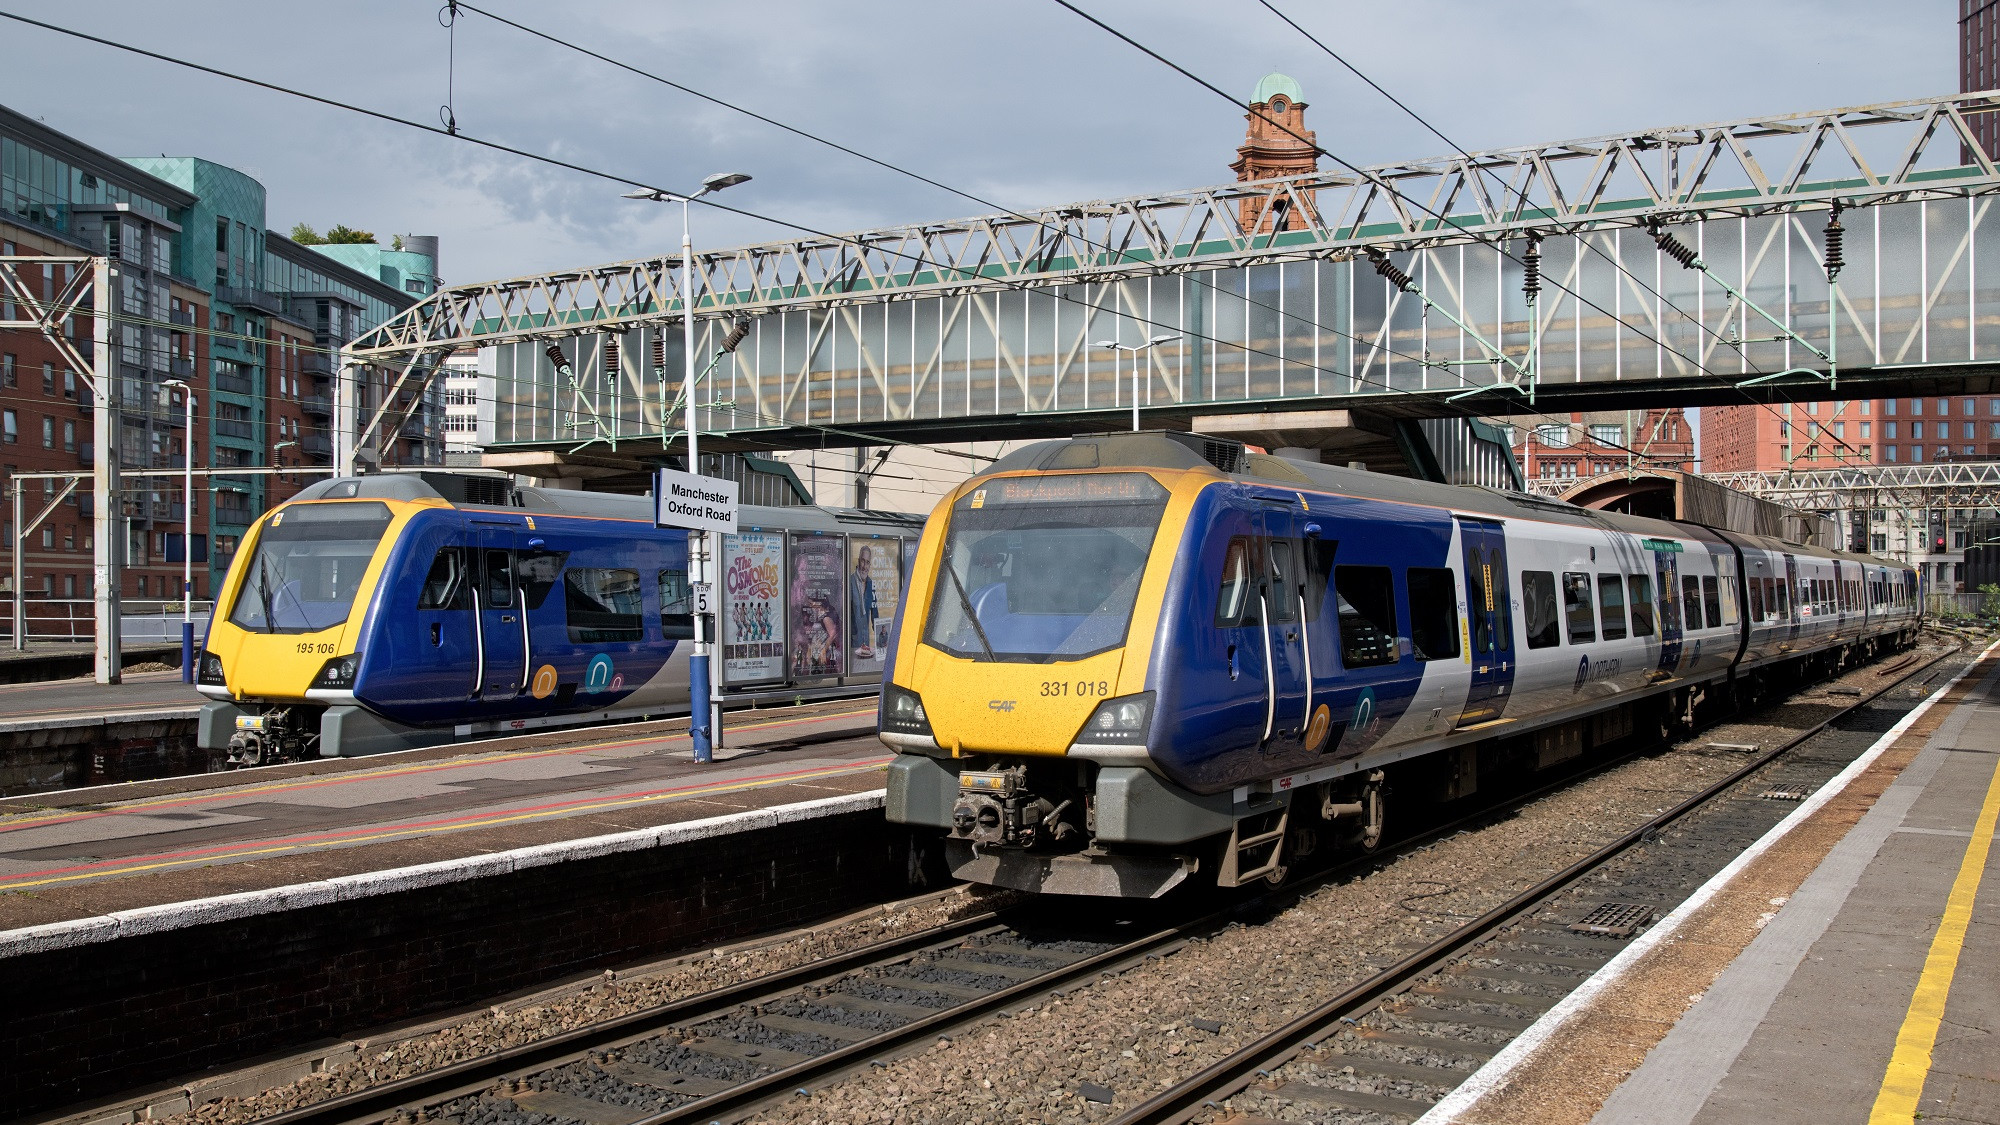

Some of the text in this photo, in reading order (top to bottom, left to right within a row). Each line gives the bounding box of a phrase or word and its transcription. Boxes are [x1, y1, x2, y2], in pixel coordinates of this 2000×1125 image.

[671, 483, 729, 504] Manchester
[668, 501, 731, 522] Oxford Road
[872, 557, 894, 568] ONLY
[872, 569, 895, 578] BAKING
[872, 579, 894, 590] BOOK
[698, 593, 707, 611] 5
[296, 643, 335, 654] 195 106
[1040, 681, 1108, 697] 331 018
[988, 699, 1017, 712] CAF
